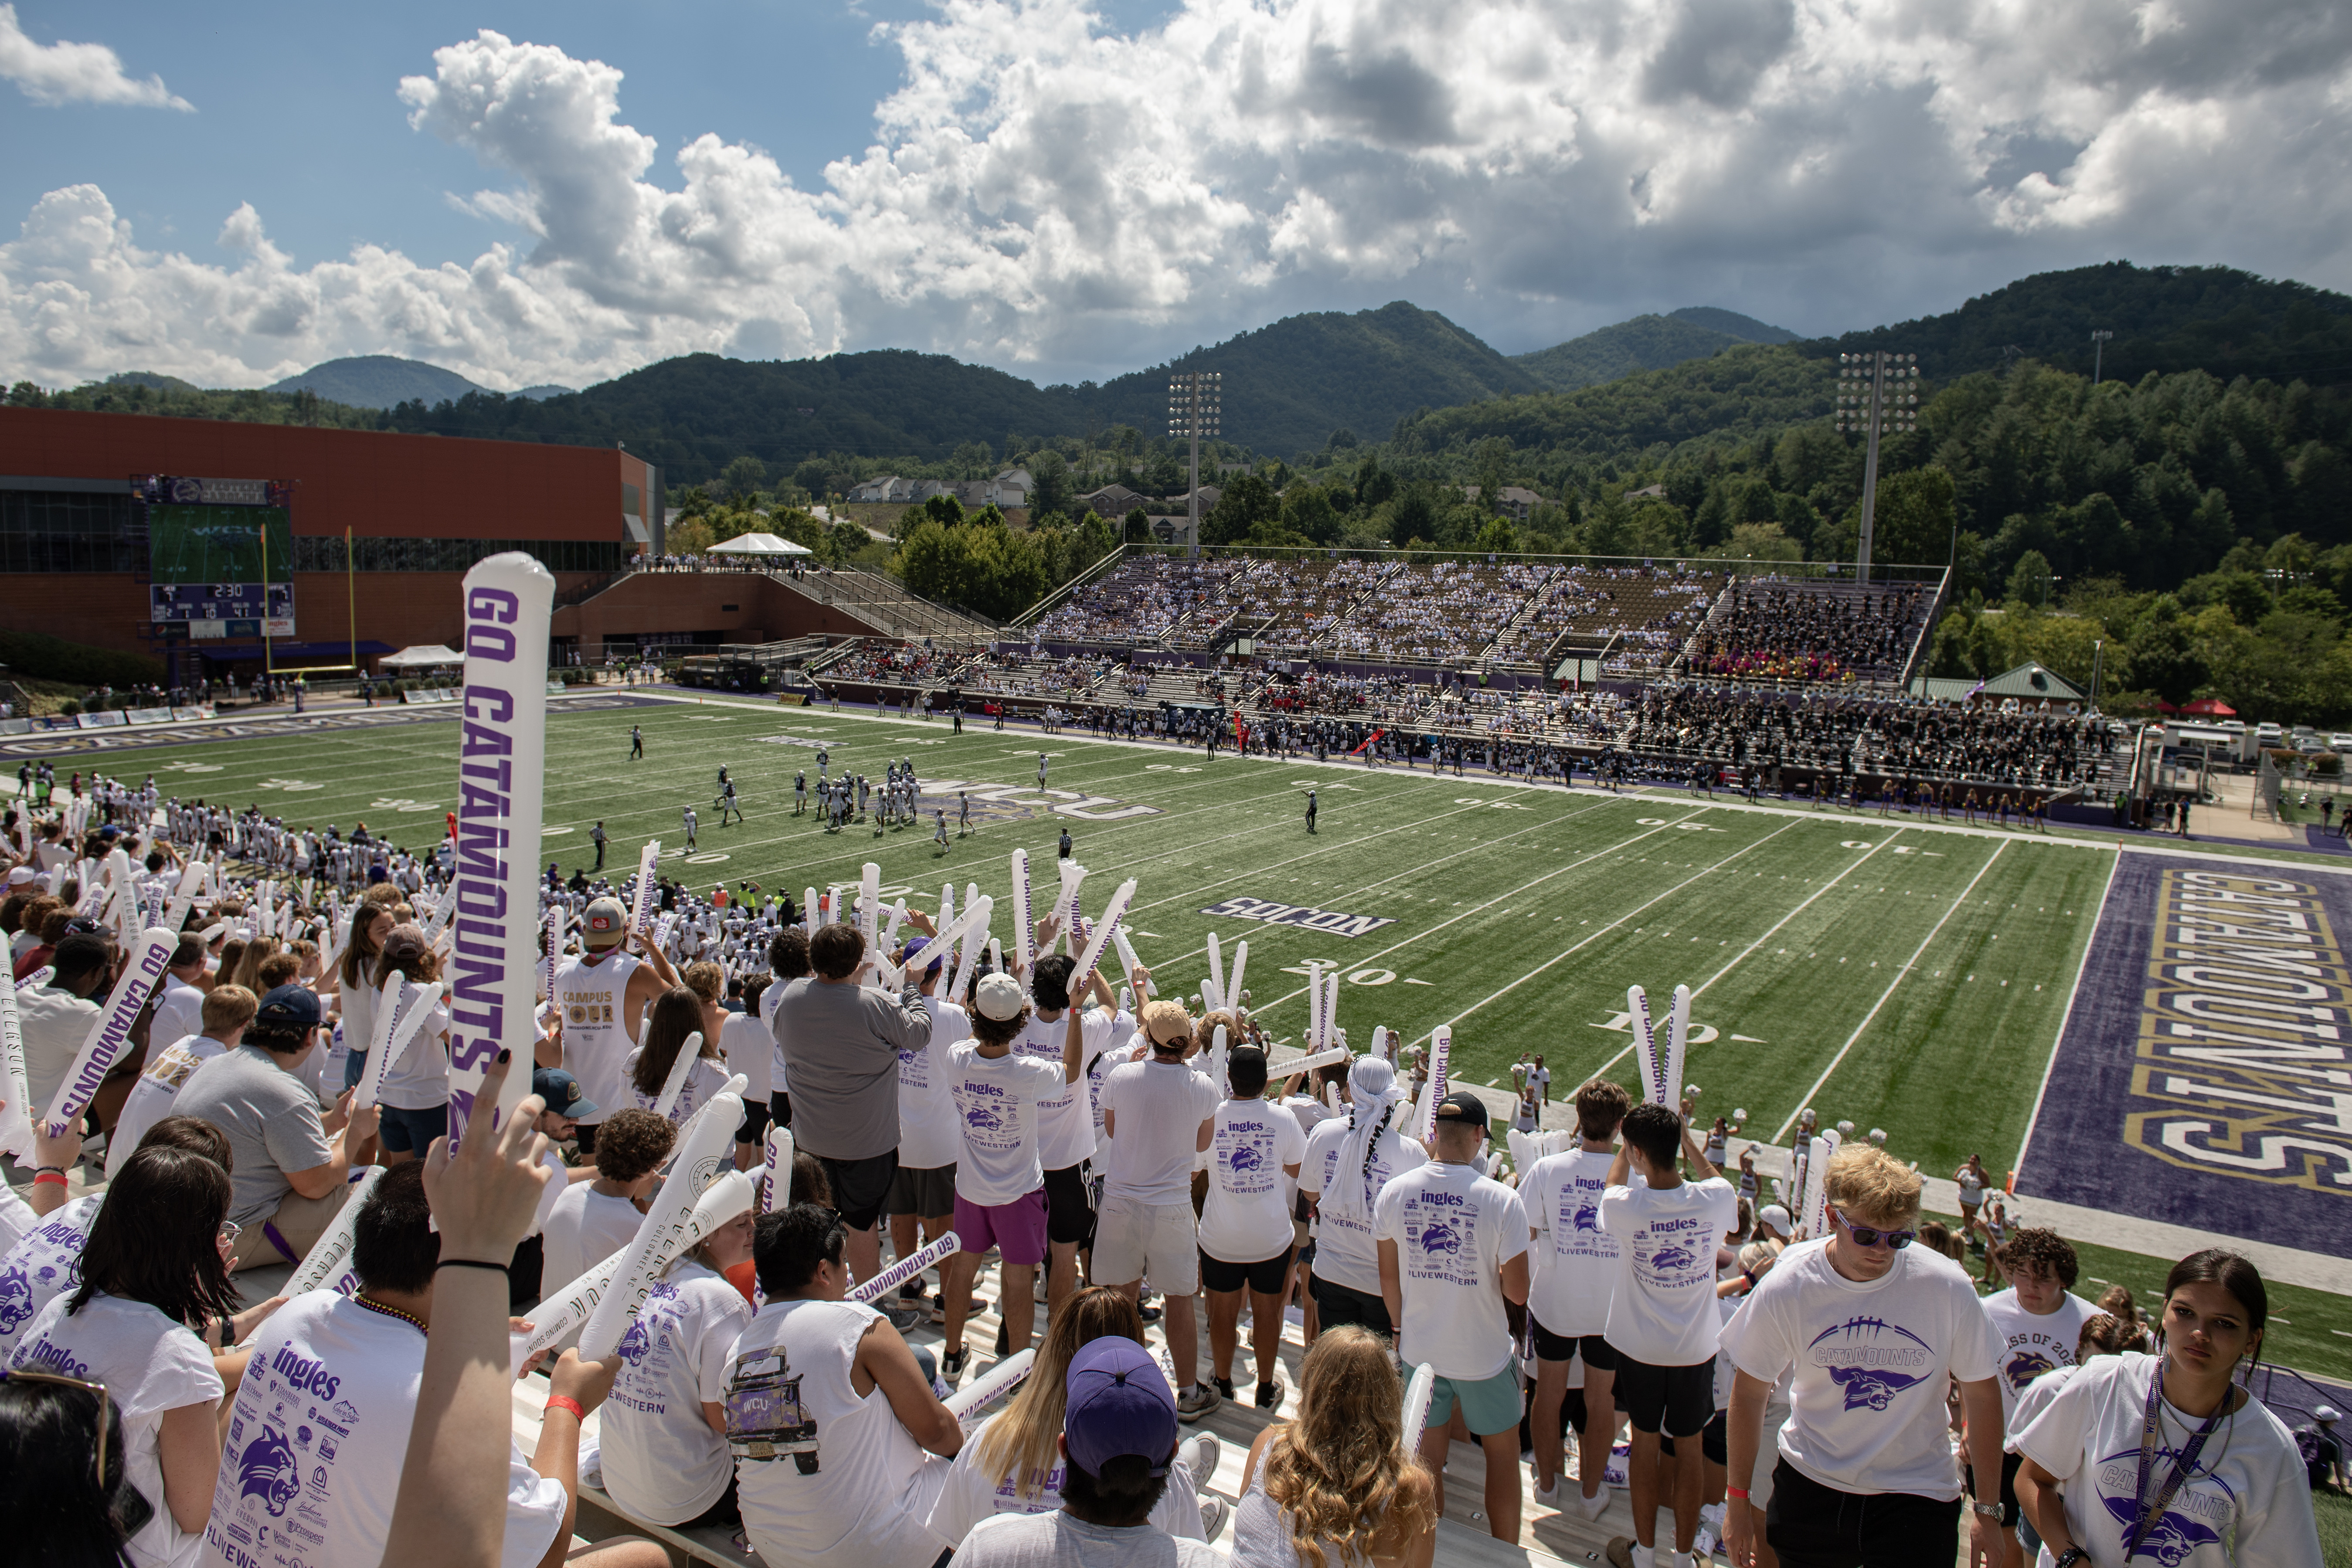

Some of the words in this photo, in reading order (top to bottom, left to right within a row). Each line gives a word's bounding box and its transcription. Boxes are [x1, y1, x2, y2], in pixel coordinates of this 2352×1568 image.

[201, 480, 265, 492] WESTERN
[201, 492, 266, 502] CAROLINA
[215, 584, 243, 597] 2:30
[467, 587, 519, 663] GO
[452, 685, 513, 1075] CATAMOUNTS
[153, 887, 163, 898] GO
[638, 872, 655, 933] CATAMOUNTS
[548, 913, 556, 927] GO
[705, 919, 710, 927] 6
[1200, 897, 1398, 937] SOCON
[1086, 924, 1092, 936] GO
[916, 926, 952, 960] EVERSON
[140, 943, 170, 977] GO
[32, 966, 48, 984] GO
[1279, 958, 1396, 985] 20
[563, 991, 612, 1003] CAMPUS
[1639, 994, 1649, 1012] GO
[564, 1004, 614, 1024] TOUR
[2, 998, 26, 1076] EVERSON
[2162, 872, 2352, 1185] CATAMOUNTS
[61, 979, 150, 1118] CATAMOUNTS
[1026, 1039, 1060, 1052] ingles
[1439, 1038, 1450, 1053] GO
[1274, 1058, 1307, 1072] EVERSON
[964, 1079, 1003, 1097] ingles
[1228, 1121, 1263, 1133] ingles
[765, 1141, 778, 1170] GO
[1223, 1183, 1274, 1193] #LIVEWESTERN
[1575, 1175, 1605, 1191] ingle
[1421, 1189, 1463, 1206] ingles
[1651, 1218, 1697, 1232] ingles
[39, 1217, 88, 1252] ingles
[938, 1235, 955, 1255] GO
[297, 1232, 352, 1295] EVERSO
[627, 1276, 638, 1288] NC
[853, 1247, 935, 1303] CATAMOUNTS
[650, 1281, 680, 1301] ngles
[546, 1316, 569, 1340] COMING
[526, 1333, 546, 1355] SOON!
[2033, 1333, 2051, 1346] OF
[1815, 1345, 1927, 1368] CATAMOUNTS
[272, 1340, 340, 1401] ingles
[277, 1383, 301, 1405] STANBERRY
[608, 1388, 666, 1414] EWESTERN
[744, 1398, 768, 1413] WCU
[267, 1411, 286, 1427] CHAMPION
[2145, 1408, 2158, 1434] WCU
[337, 1425, 350, 1436] PARTS
[1034, 1492, 1061, 1501] SANBERRY
[2155, 1489, 2172, 1510] WCU
[295, 1501, 323, 1517] Jackson
[273, 1529, 291, 1543] Western
[296, 1523, 324, 1542] Prospect
[297, 1533, 321, 1546] CULLOWHEE
[207, 1523, 262, 1568] #LIVEWE
[275, 1536, 290, 1548] Carolina
